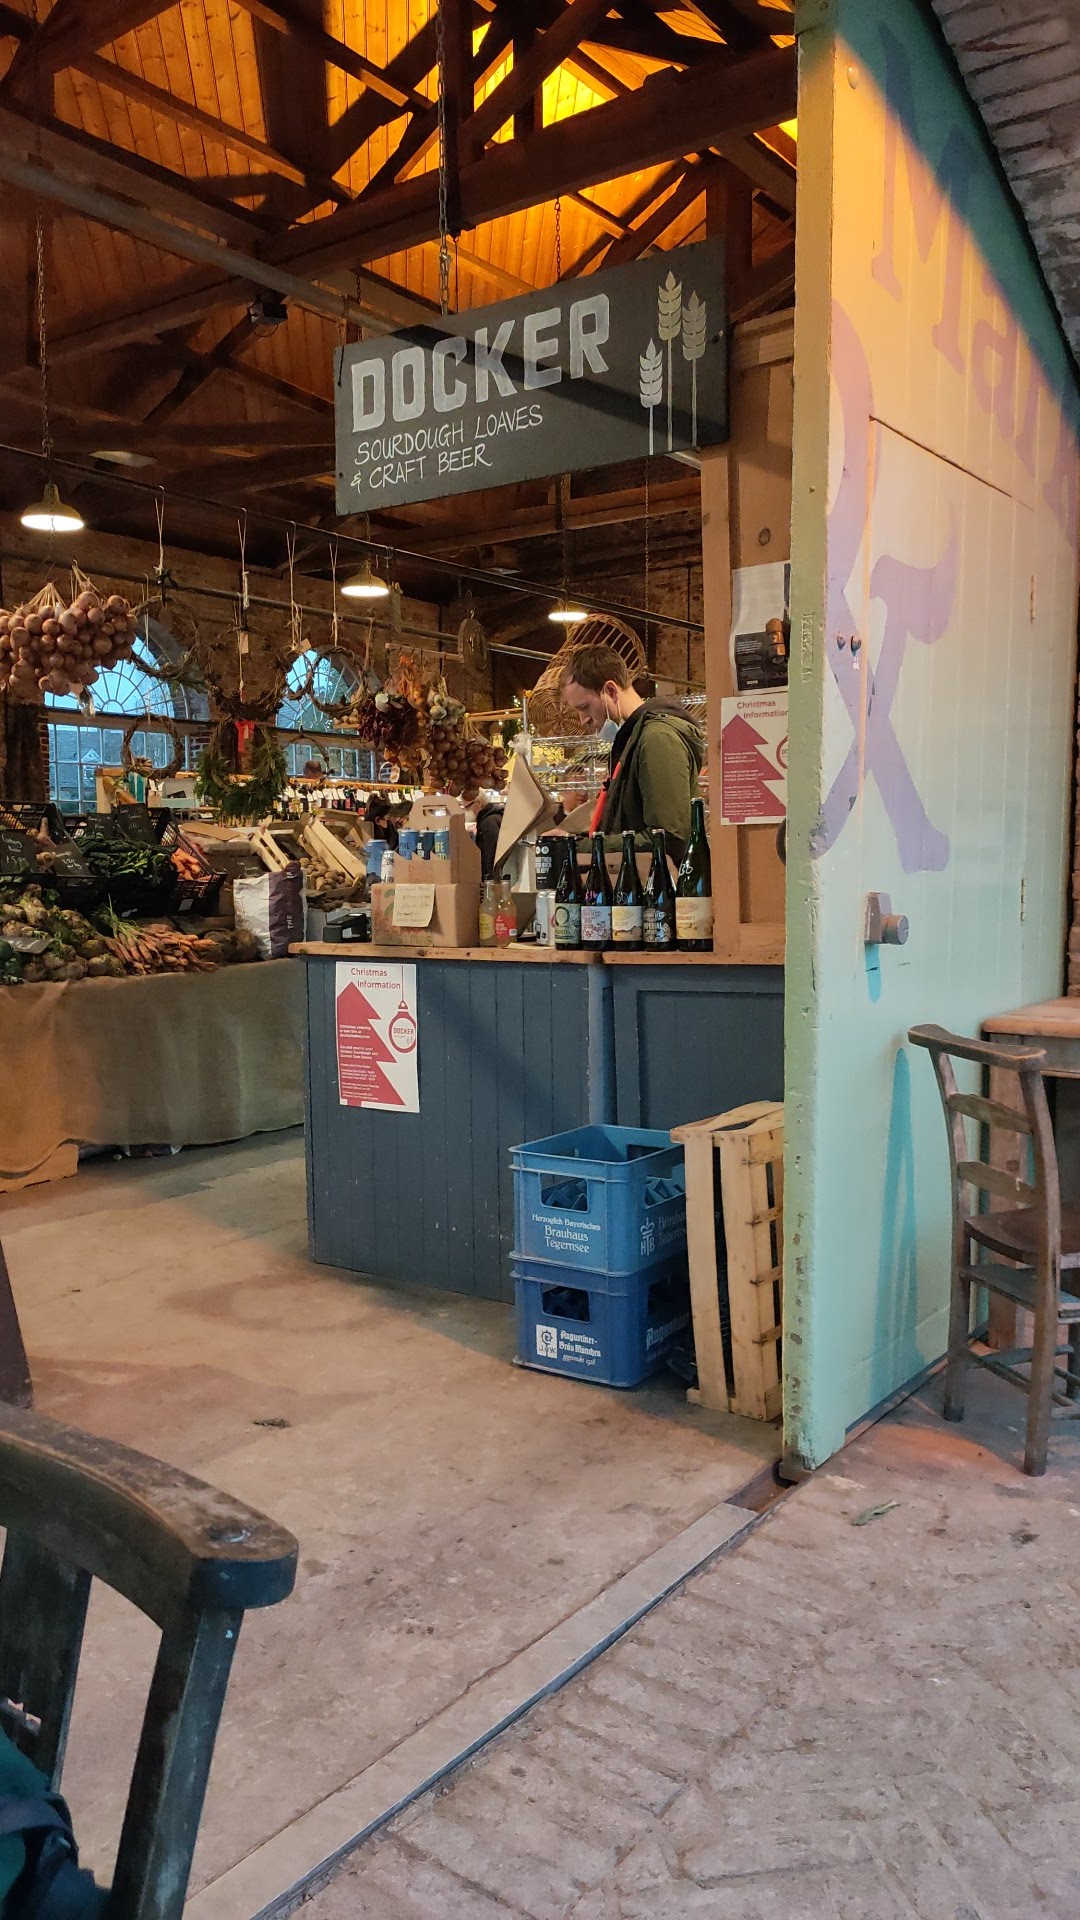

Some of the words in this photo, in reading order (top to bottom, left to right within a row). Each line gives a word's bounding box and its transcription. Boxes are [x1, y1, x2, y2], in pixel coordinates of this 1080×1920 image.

[351, 293, 610, 433] DOCKER
[354, 420, 464, 466] SOURDOUGH
[474, 404, 544, 441] LOAVES
[350, 471, 362, 494] &
[368, 458, 424, 490] CRAFT
[437, 443, 493, 476] BEER
[736, 700, 776, 712] Christmas
[350, 968, 388, 977] Christmas
[357, 980, 401, 990] Information
[393, 1027, 415, 1035] DOCKER
[544, 1224, 589, 1242] Brauhaus
[544, 1235, 590, 1254] Tegernsee
